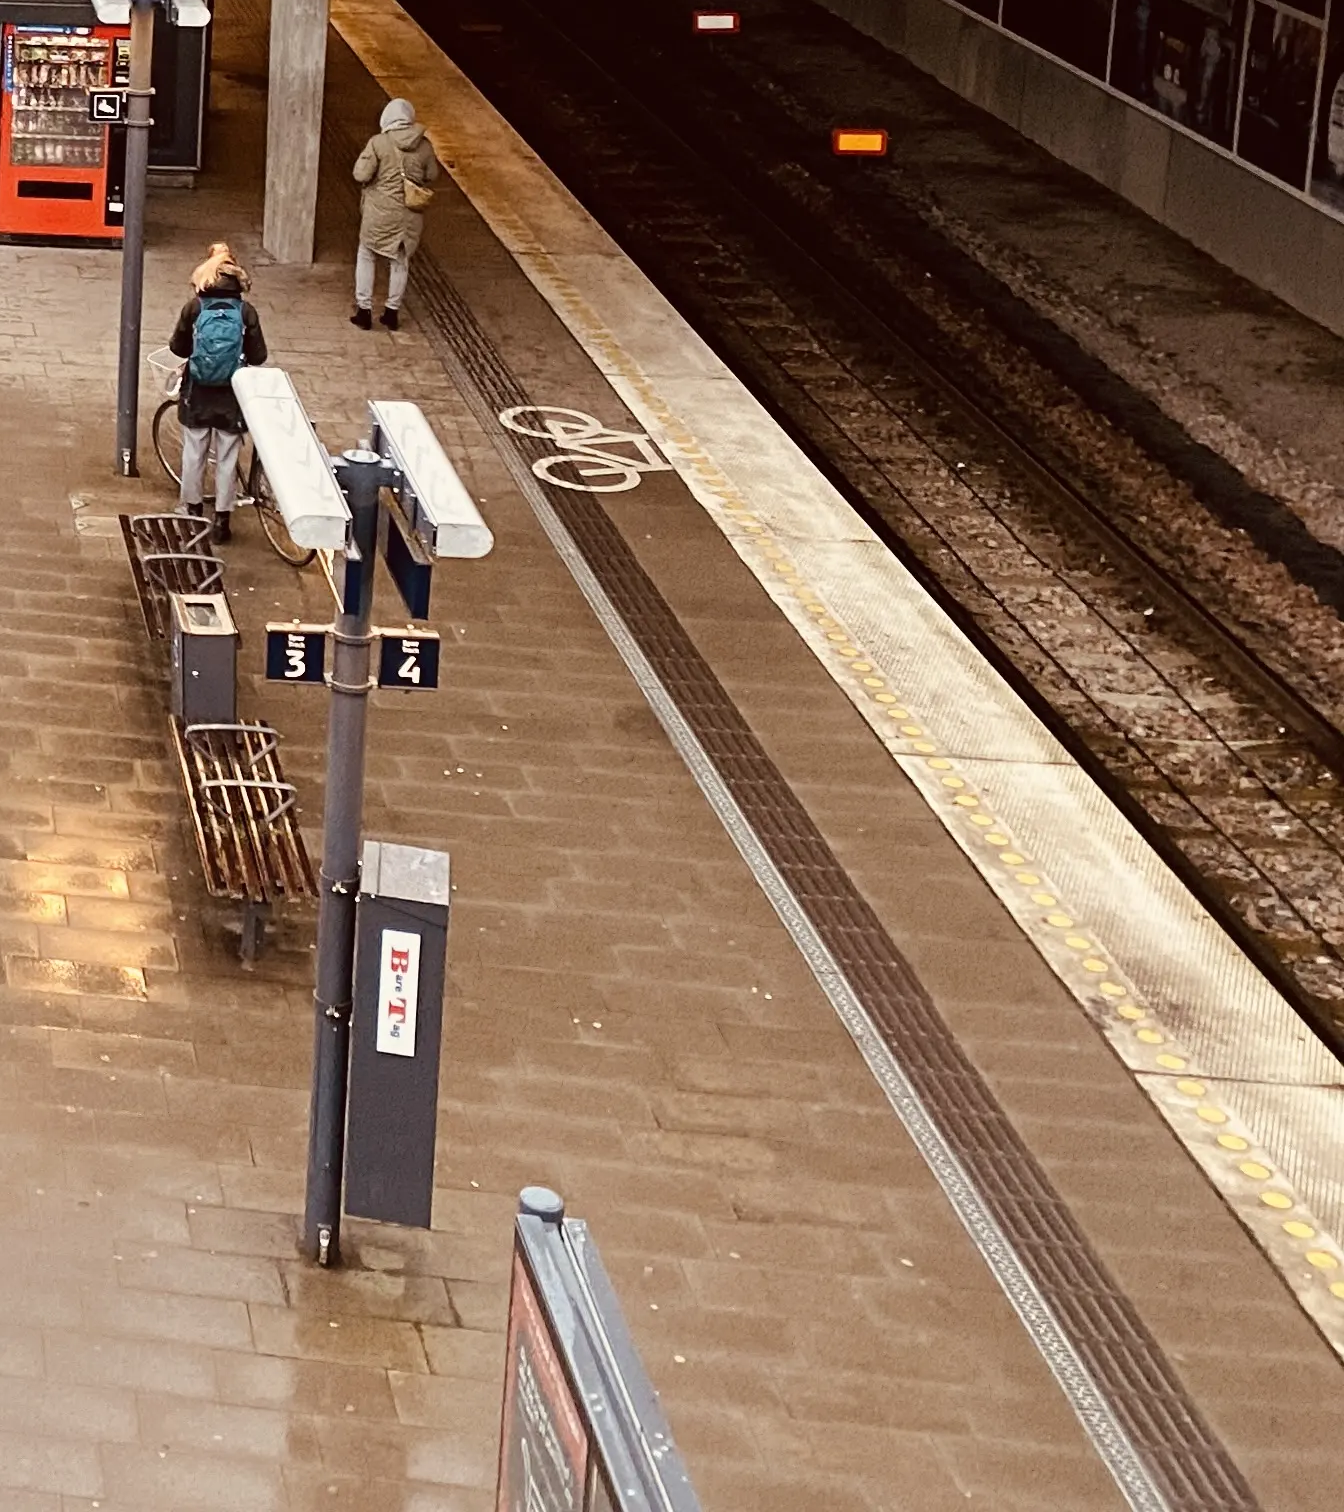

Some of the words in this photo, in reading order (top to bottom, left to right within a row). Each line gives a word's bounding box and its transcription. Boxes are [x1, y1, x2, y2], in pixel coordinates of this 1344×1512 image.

[284, 649, 306, 678] 3
[397, 655, 421, 684] 4
[390, 946, 410, 993] Bare
[387, 998, 408, 1038] Tag
